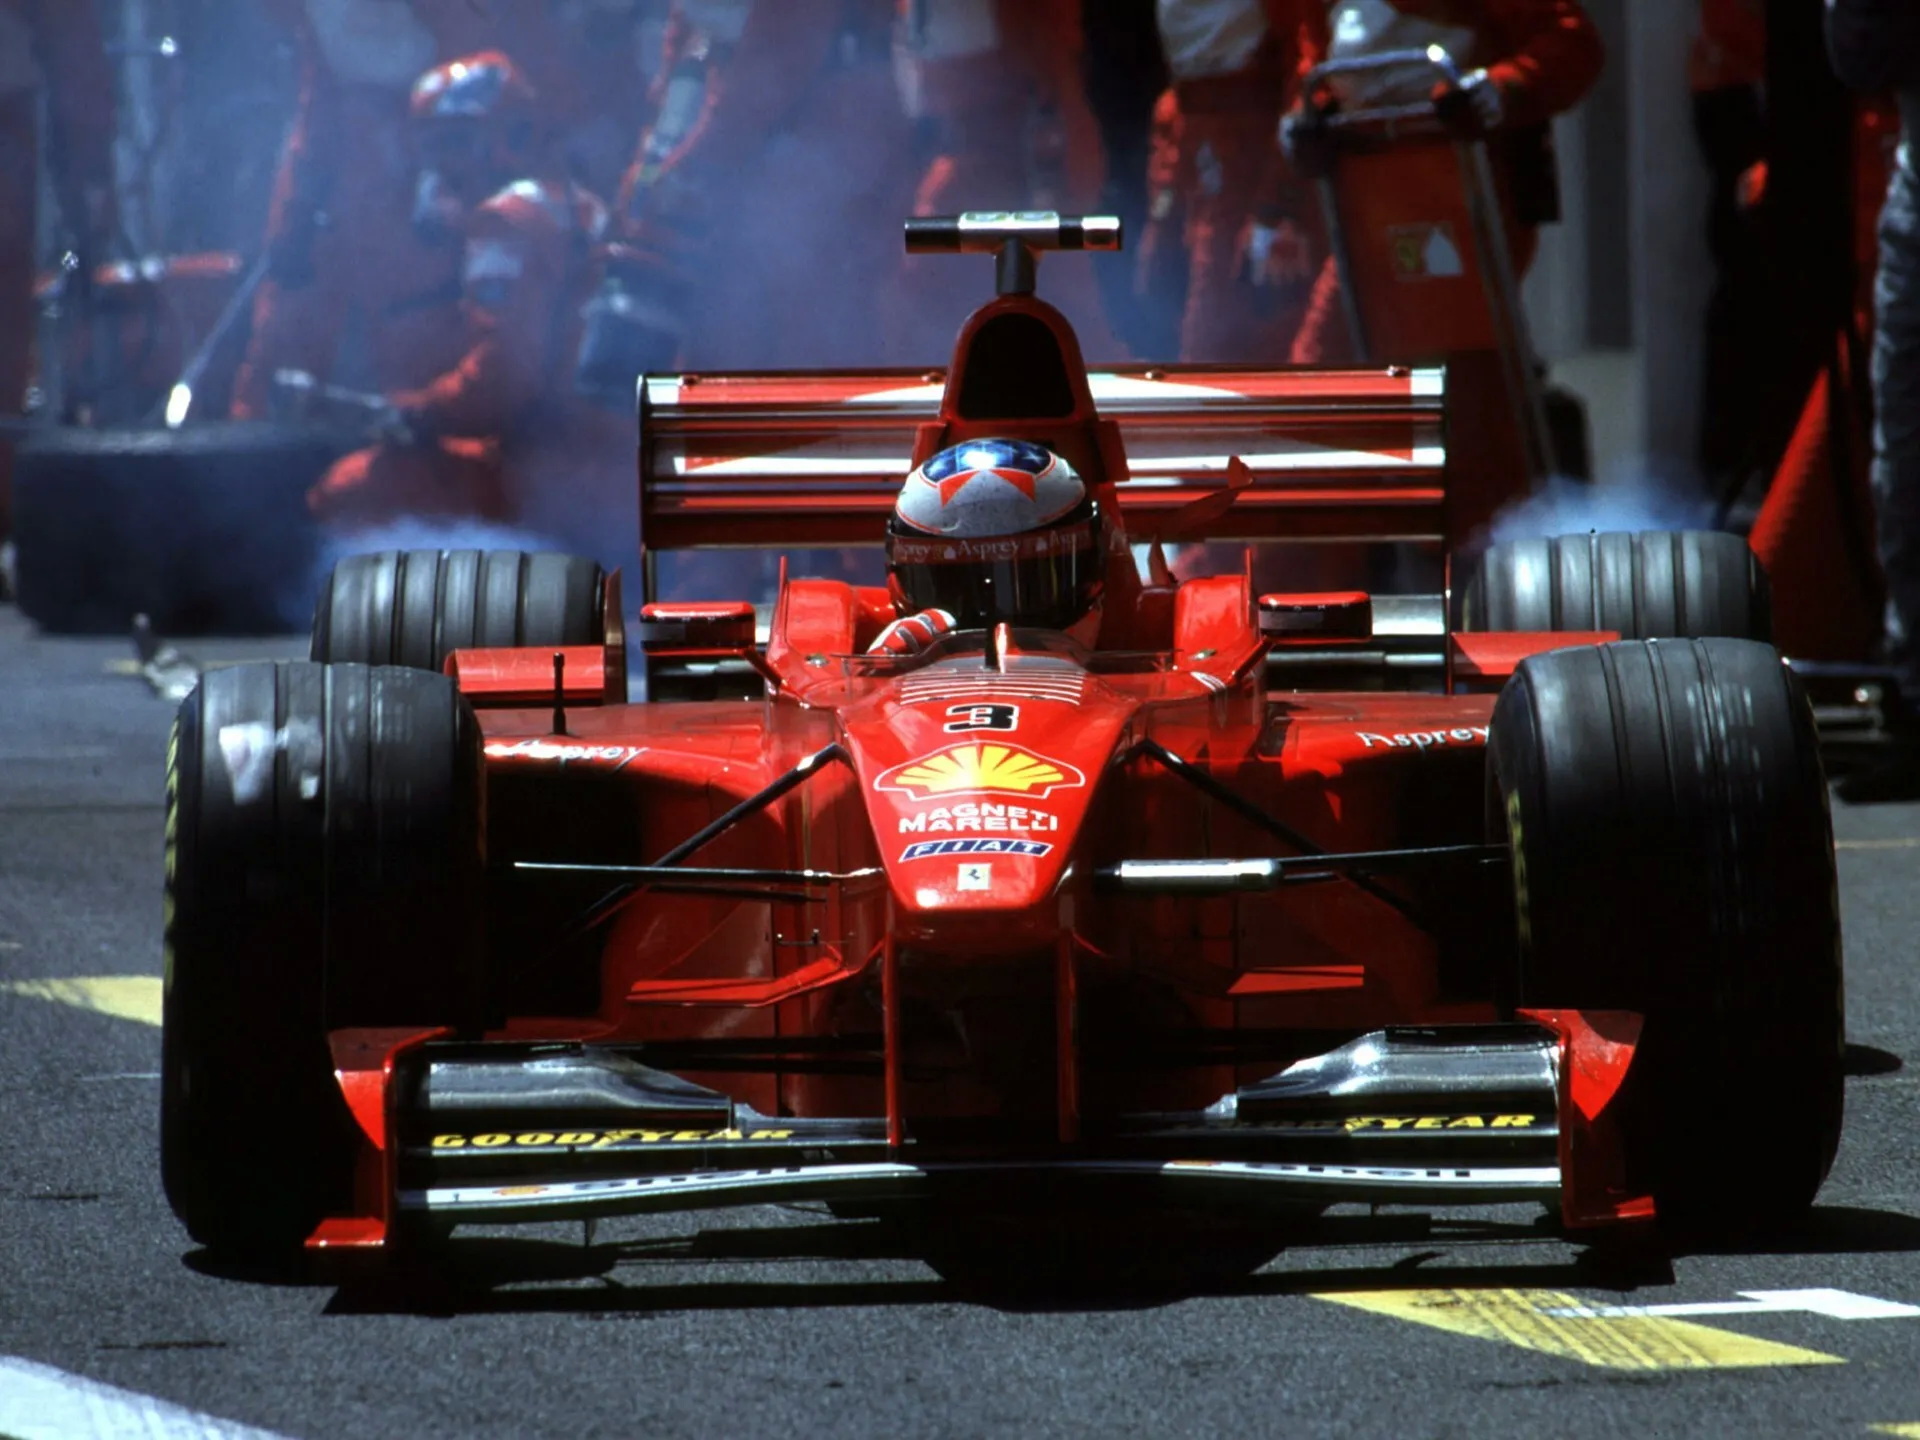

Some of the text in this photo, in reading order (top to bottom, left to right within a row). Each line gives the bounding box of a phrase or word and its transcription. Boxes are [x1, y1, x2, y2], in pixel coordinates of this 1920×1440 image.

[958, 539, 1021, 560] Asprey
[943, 703, 1020, 733] 3
[1355, 725, 1490, 754] Asprey
[899, 803, 1058, 826] MAGNETI
[899, 813, 1058, 833] MARELLI
[912, 839, 1044, 856] FIAT
